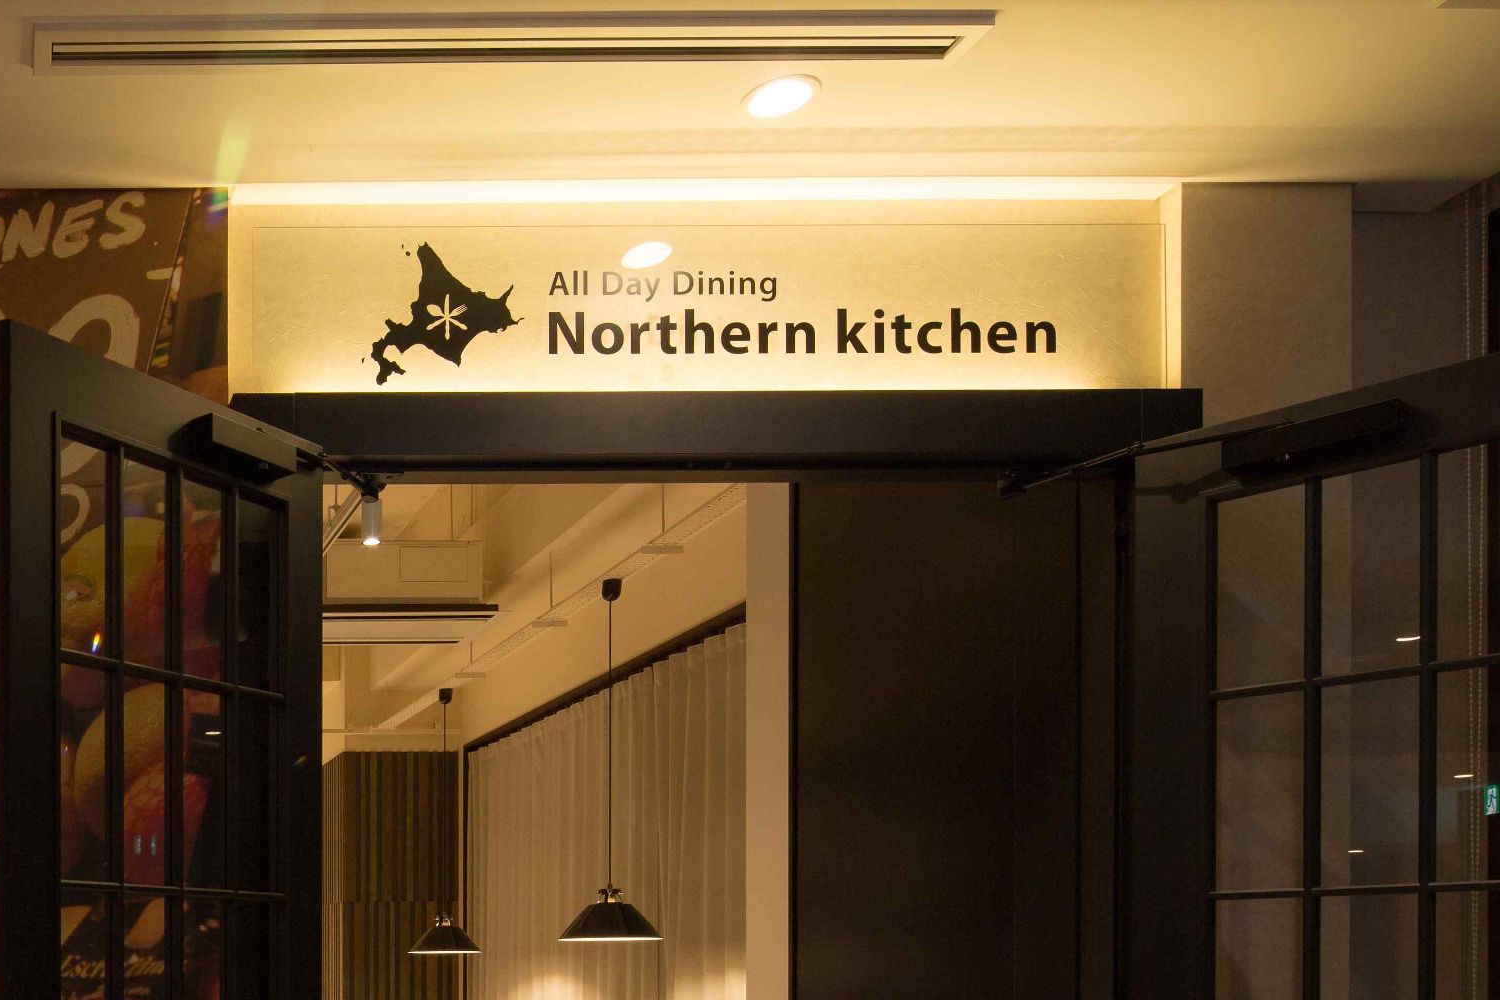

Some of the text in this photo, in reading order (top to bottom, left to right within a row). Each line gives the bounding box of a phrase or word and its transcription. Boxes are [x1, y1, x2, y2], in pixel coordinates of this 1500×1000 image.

[549, 270, 777, 303] All Day Dining
[548, 307, 1057, 355] Northern kitchen
